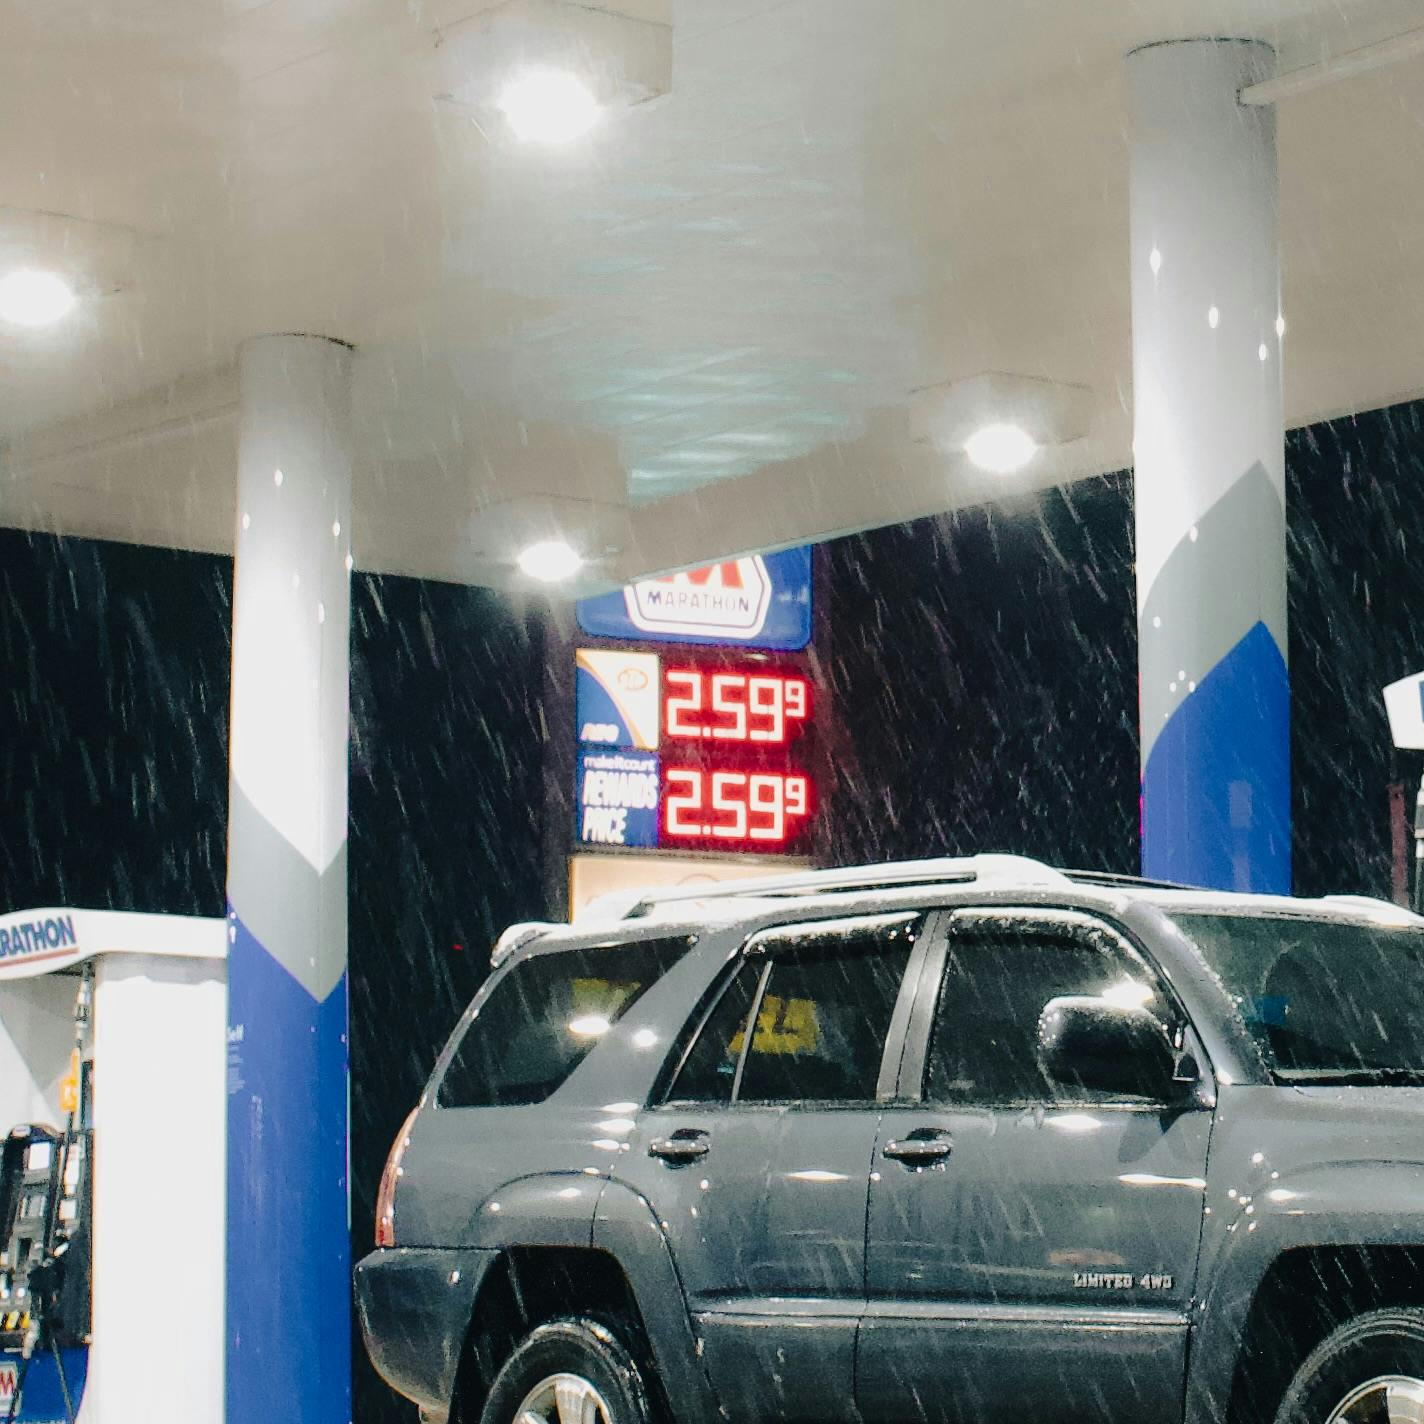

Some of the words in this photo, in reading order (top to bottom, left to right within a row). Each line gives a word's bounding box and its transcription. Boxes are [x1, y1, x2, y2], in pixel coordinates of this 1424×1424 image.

[648, 590, 749, 612] MARATHON
[0, 915, 76, 957] RATHON
[1073, 1273, 1132, 1289] LIMITED
[1140, 1273, 1172, 1289] 4WD
